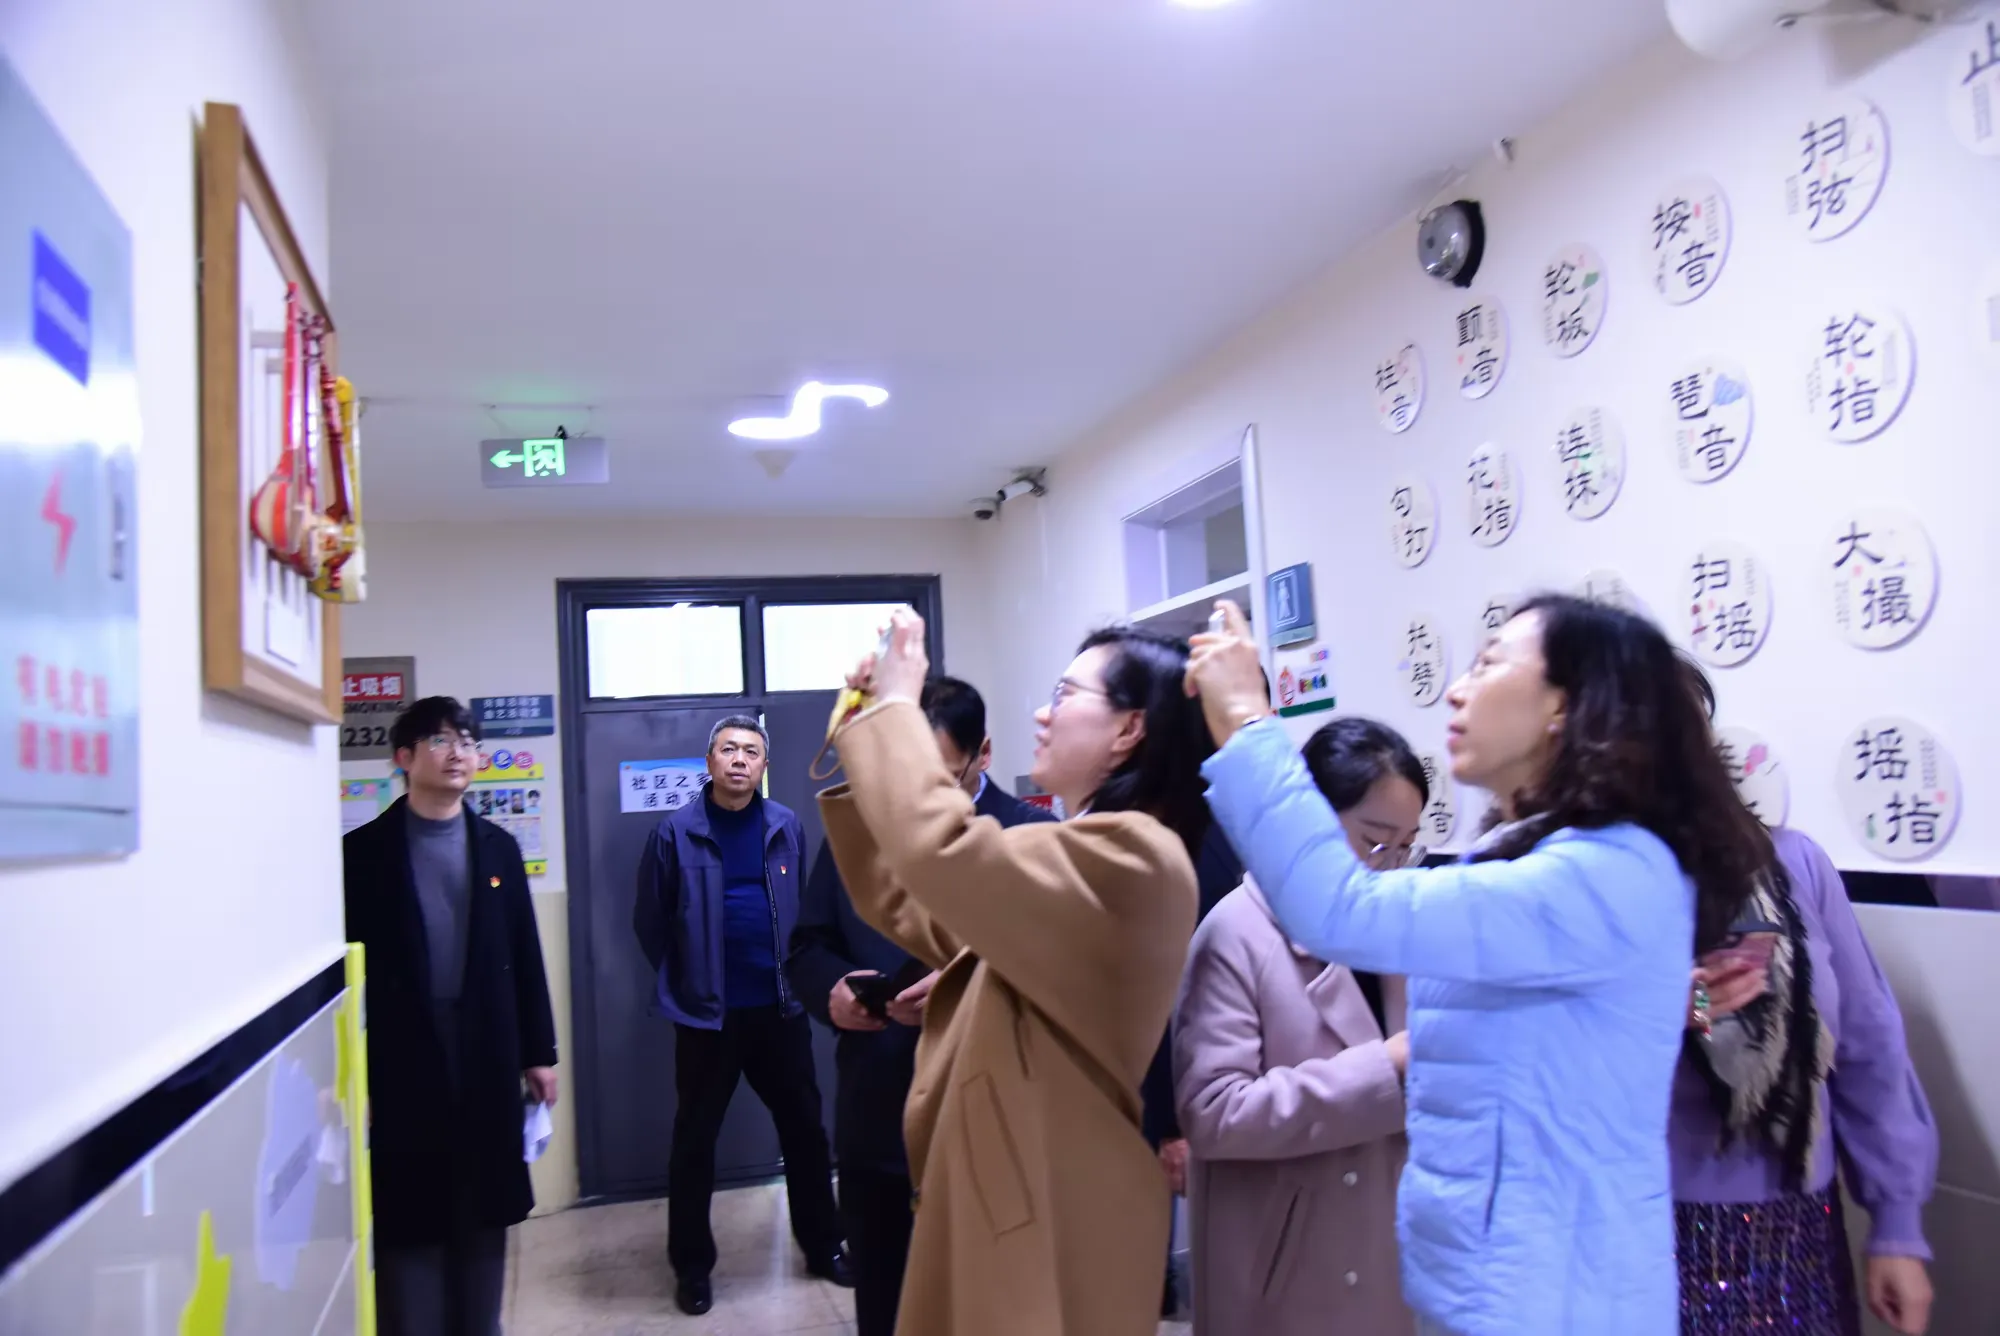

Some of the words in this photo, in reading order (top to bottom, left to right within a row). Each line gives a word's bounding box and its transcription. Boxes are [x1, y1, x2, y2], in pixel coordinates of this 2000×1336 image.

[1801, 115, 1855, 231] 扫弦
[1652, 196, 1716, 288] 按音
[1669, 372, 1736, 471] 琶音
[1824, 312, 1881, 432] 轮指
[1692, 552, 1757, 652] 扫摇
[1833, 521, 1916, 630] 大撮
[630, 772, 711, 790] 社区之家
[1853, 728, 1940, 844] 摇指
